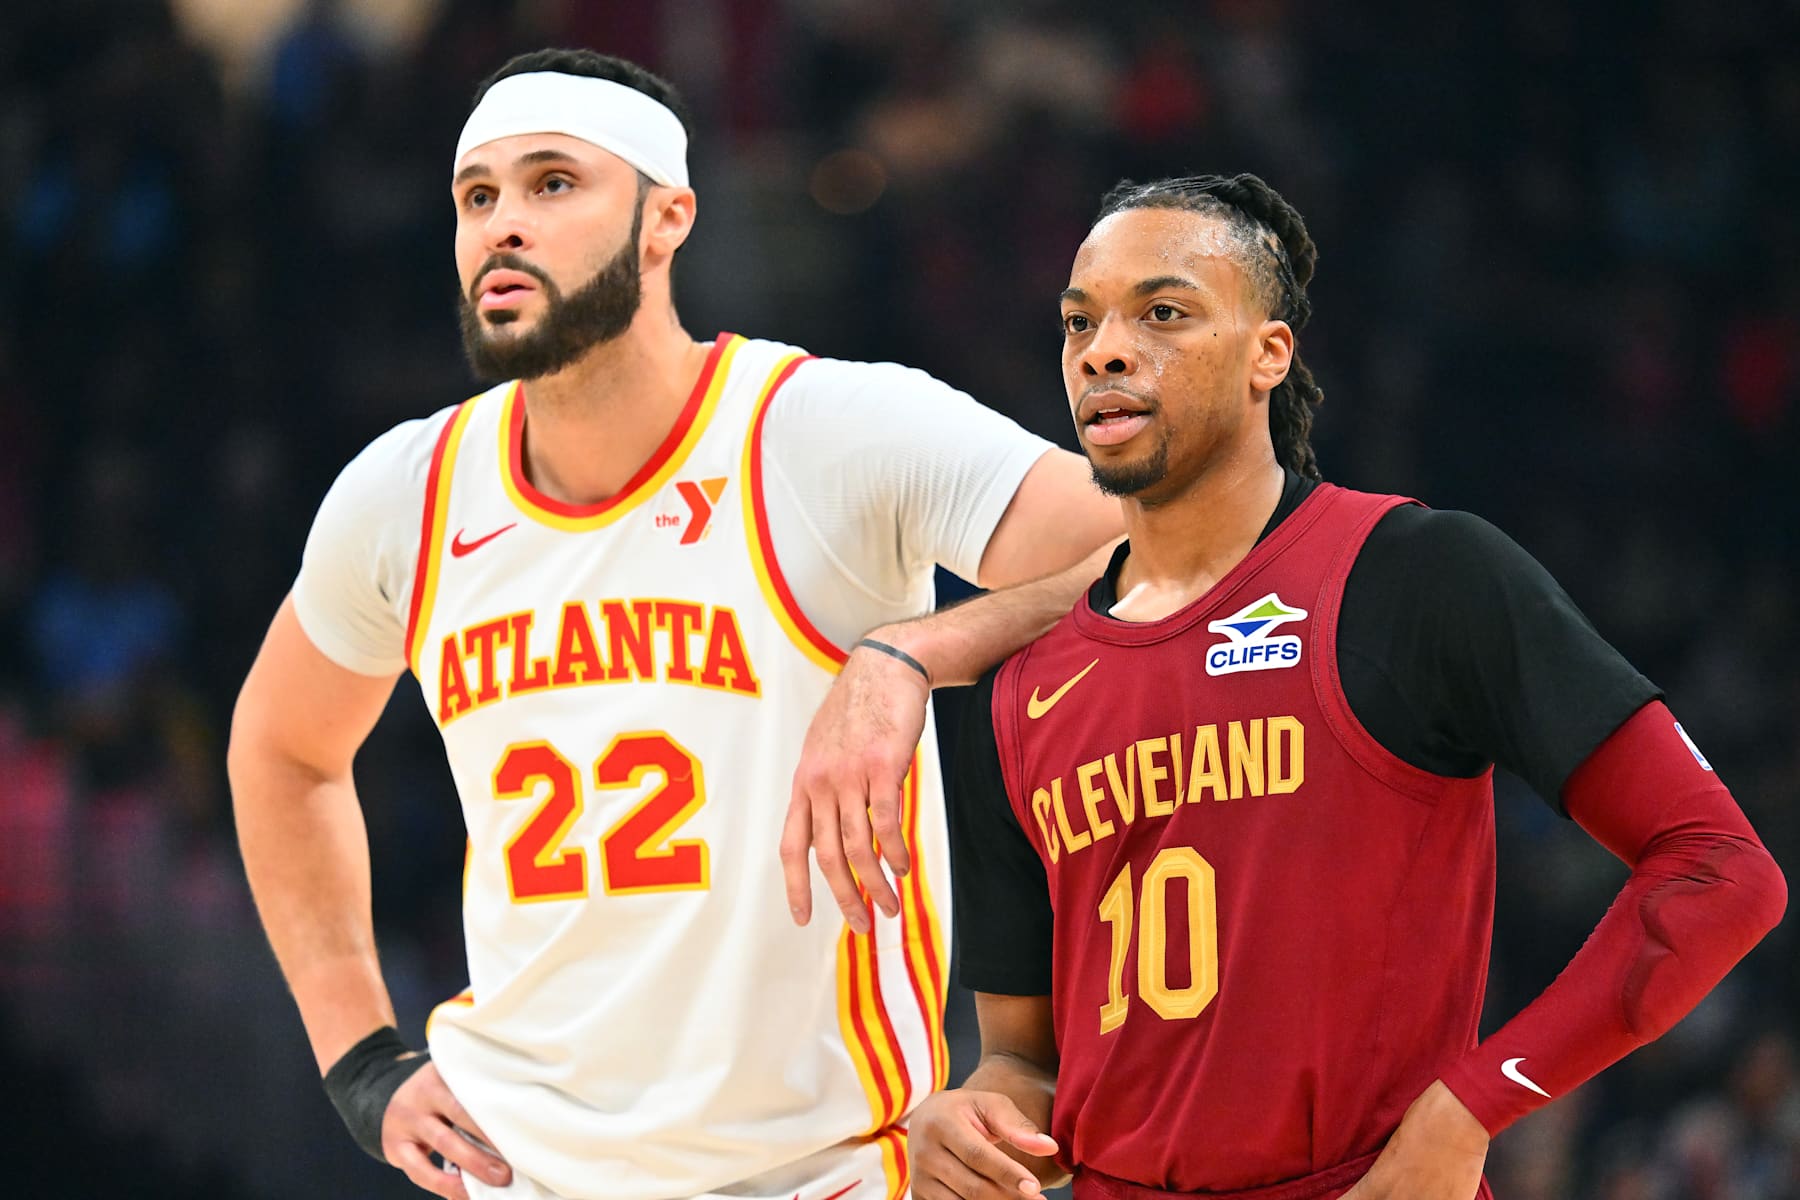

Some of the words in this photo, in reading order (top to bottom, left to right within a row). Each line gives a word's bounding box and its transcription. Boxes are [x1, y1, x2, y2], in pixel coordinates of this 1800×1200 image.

[655, 513, 680, 528] the
[440, 599, 762, 726] ATLANTA
[1210, 642, 1298, 668] CLIFFS
[491, 730, 711, 904] 22
[1032, 716, 1304, 864] CLEVELAND
[1098, 846, 1219, 1036] 10
